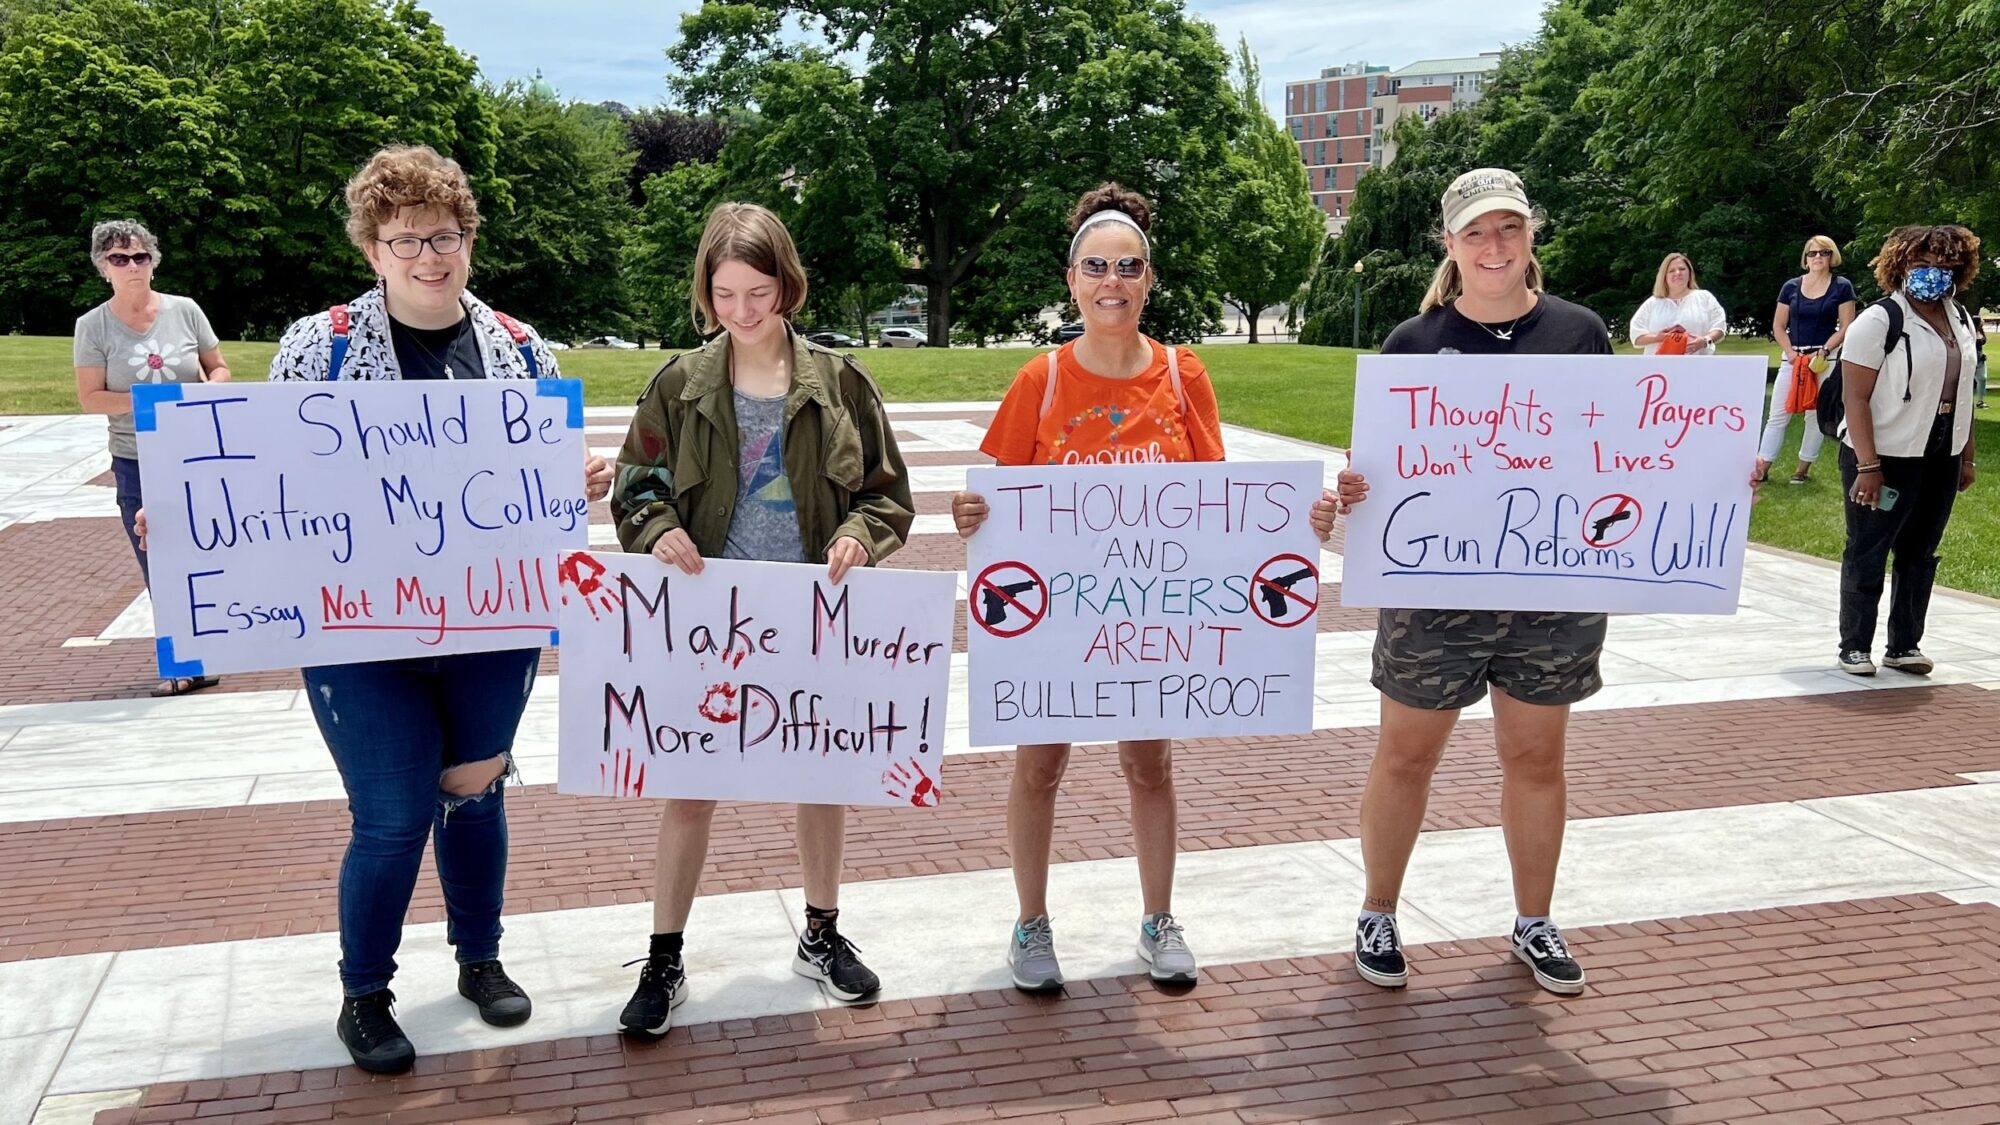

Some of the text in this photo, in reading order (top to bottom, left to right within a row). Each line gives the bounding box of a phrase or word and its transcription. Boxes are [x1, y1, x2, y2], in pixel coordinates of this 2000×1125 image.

[175, 388, 562, 464] I Should Be
[1389, 374, 1745, 449] Thoughts + Prayers
[1398, 440, 1676, 479] Won't Save Lives
[184, 468, 588, 564] Writing My College
[996, 476, 1298, 537] THOUGHTS
[1381, 486, 1737, 577] Gun Reforms Will
[1103, 537, 1188, 573] AND
[186, 557, 551, 646] Essay Not My Will
[619, 572, 944, 666] Make Murder
[1048, 571, 1250, 618] PRAYERS
[1083, 620, 1243, 666] AREN'T
[603, 681, 718, 757] More
